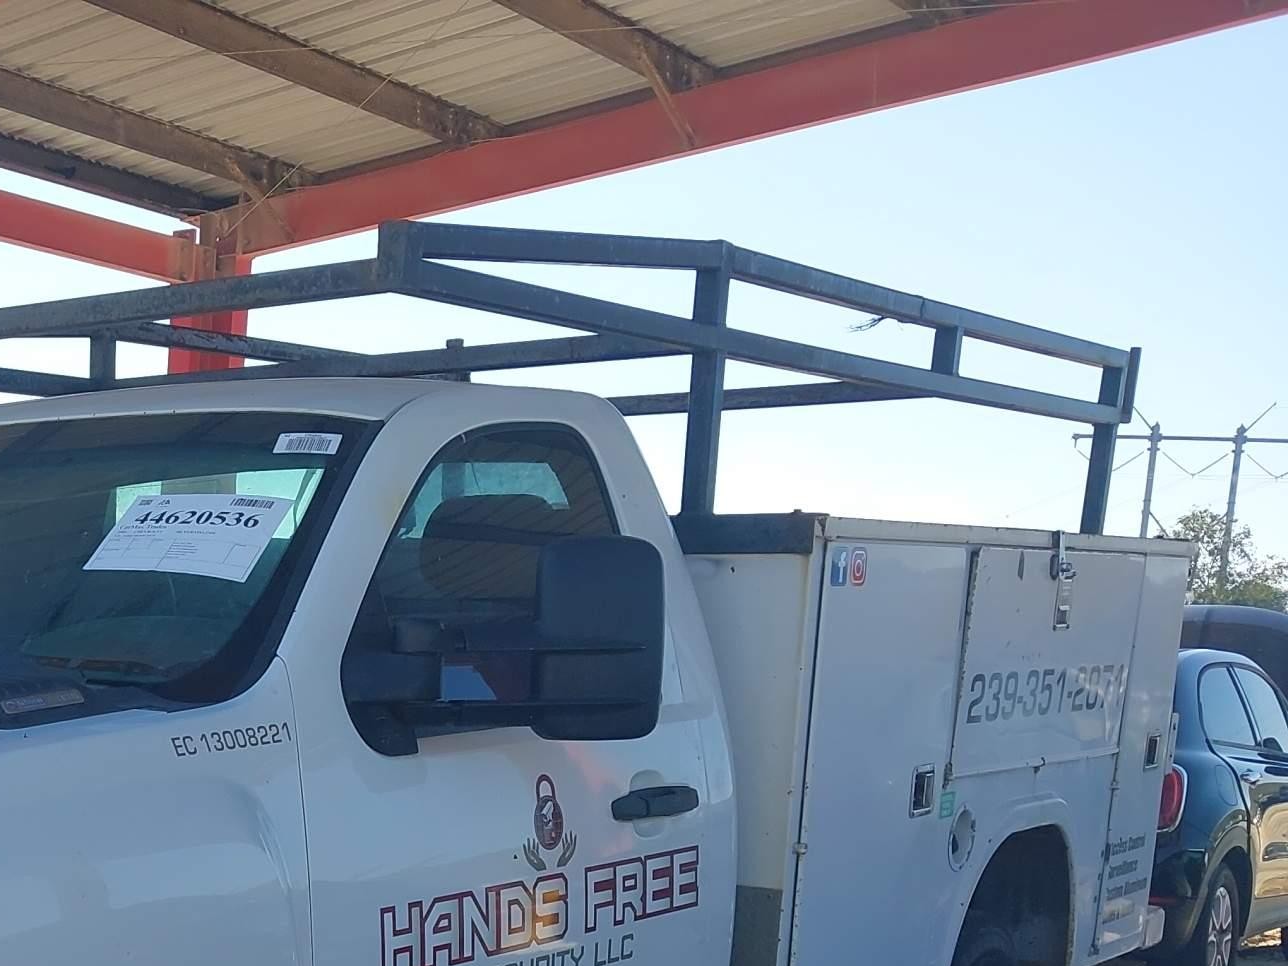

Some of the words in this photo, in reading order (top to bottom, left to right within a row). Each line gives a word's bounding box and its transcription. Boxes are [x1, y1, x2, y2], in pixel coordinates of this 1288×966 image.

[134, 510, 264, 529] 44620536
[170, 735, 198, 757] EC
[200, 721, 292, 753] 13008221
[584, 844, 699, 934] FREE
